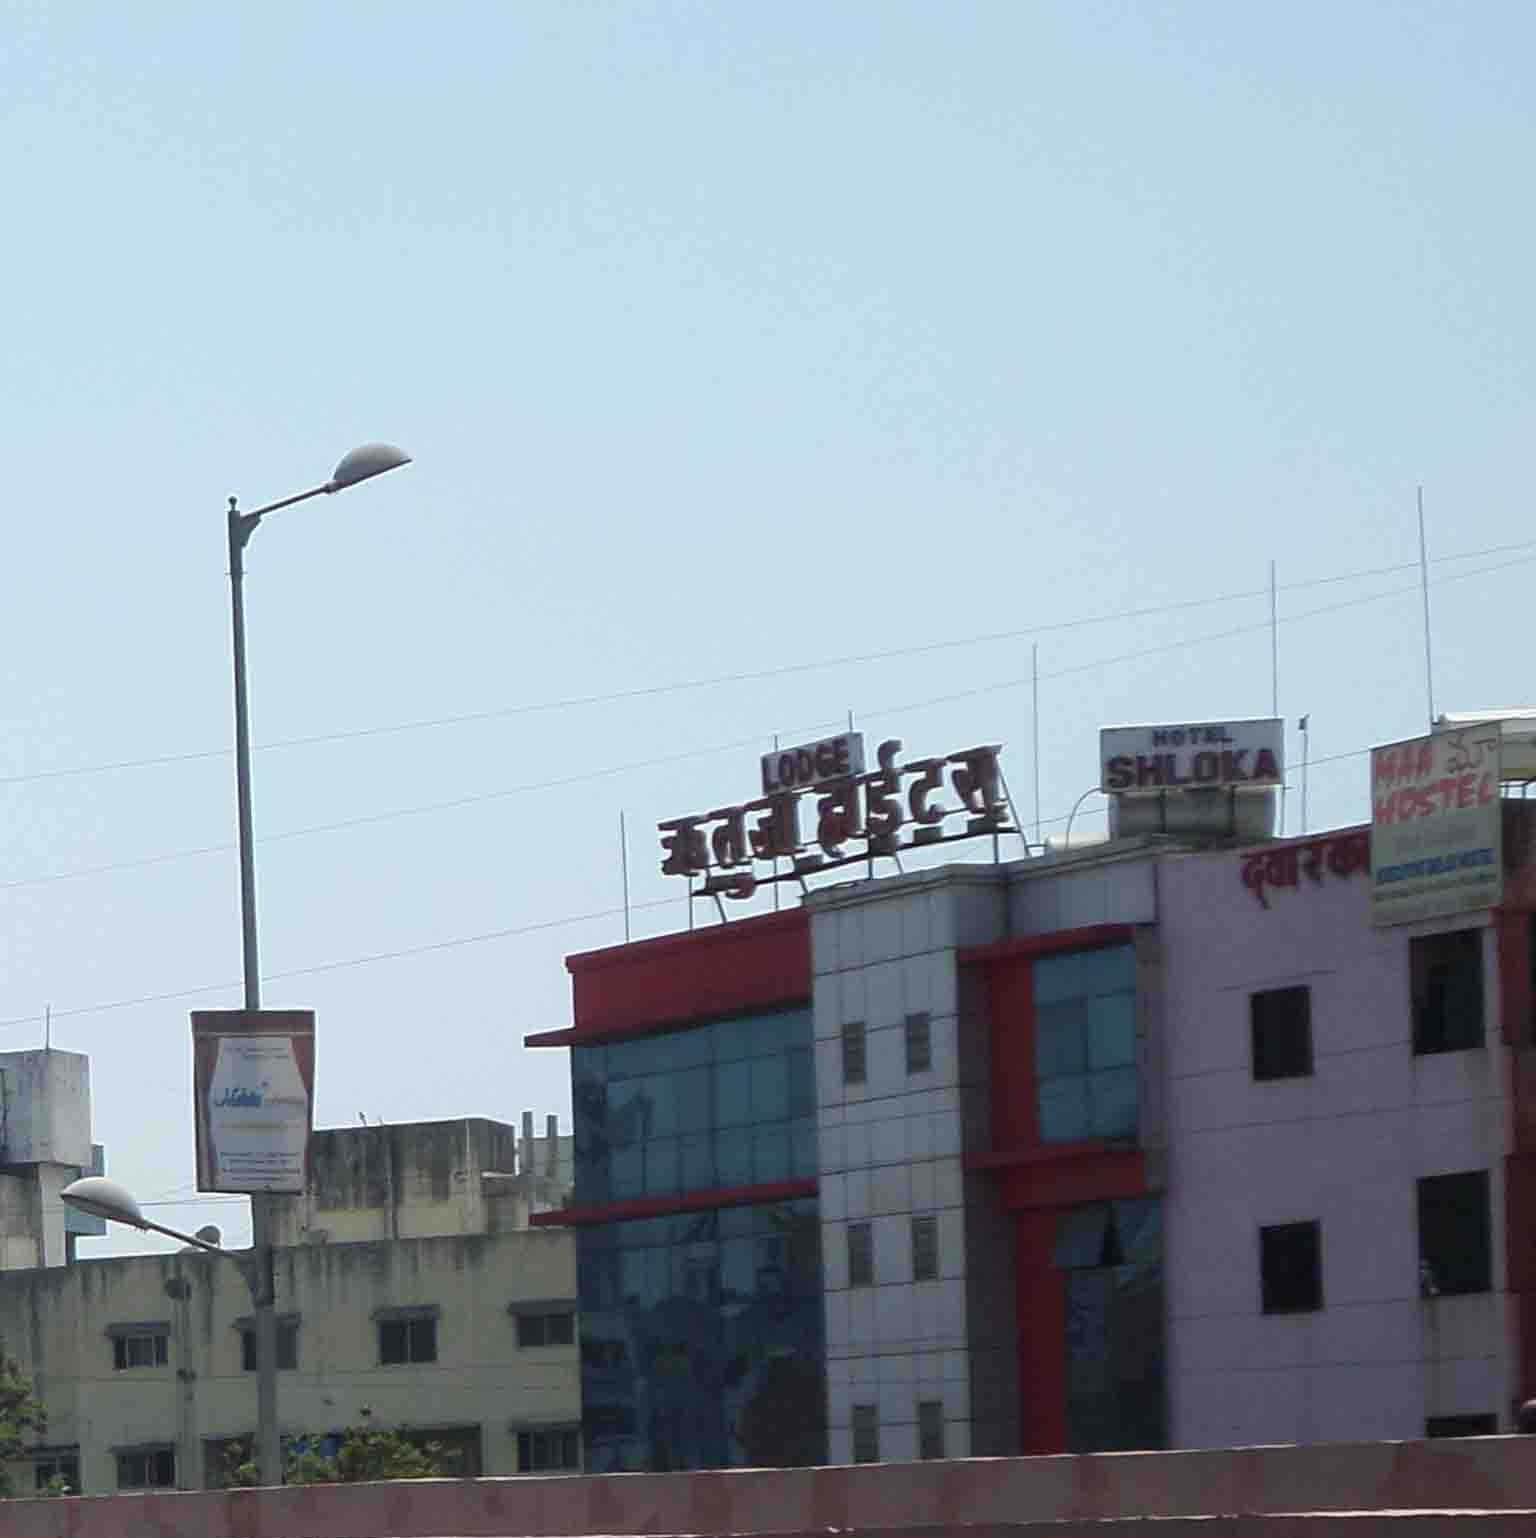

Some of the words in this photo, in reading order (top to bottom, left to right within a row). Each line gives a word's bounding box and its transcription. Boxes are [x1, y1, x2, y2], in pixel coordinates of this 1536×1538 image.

[1152, 726, 1235, 747] HOTEL
[762, 736, 849, 792] LODGE
[1105, 747, 1280, 788] SHLOKA
[1376, 771, 1497, 824] HOSTEL
